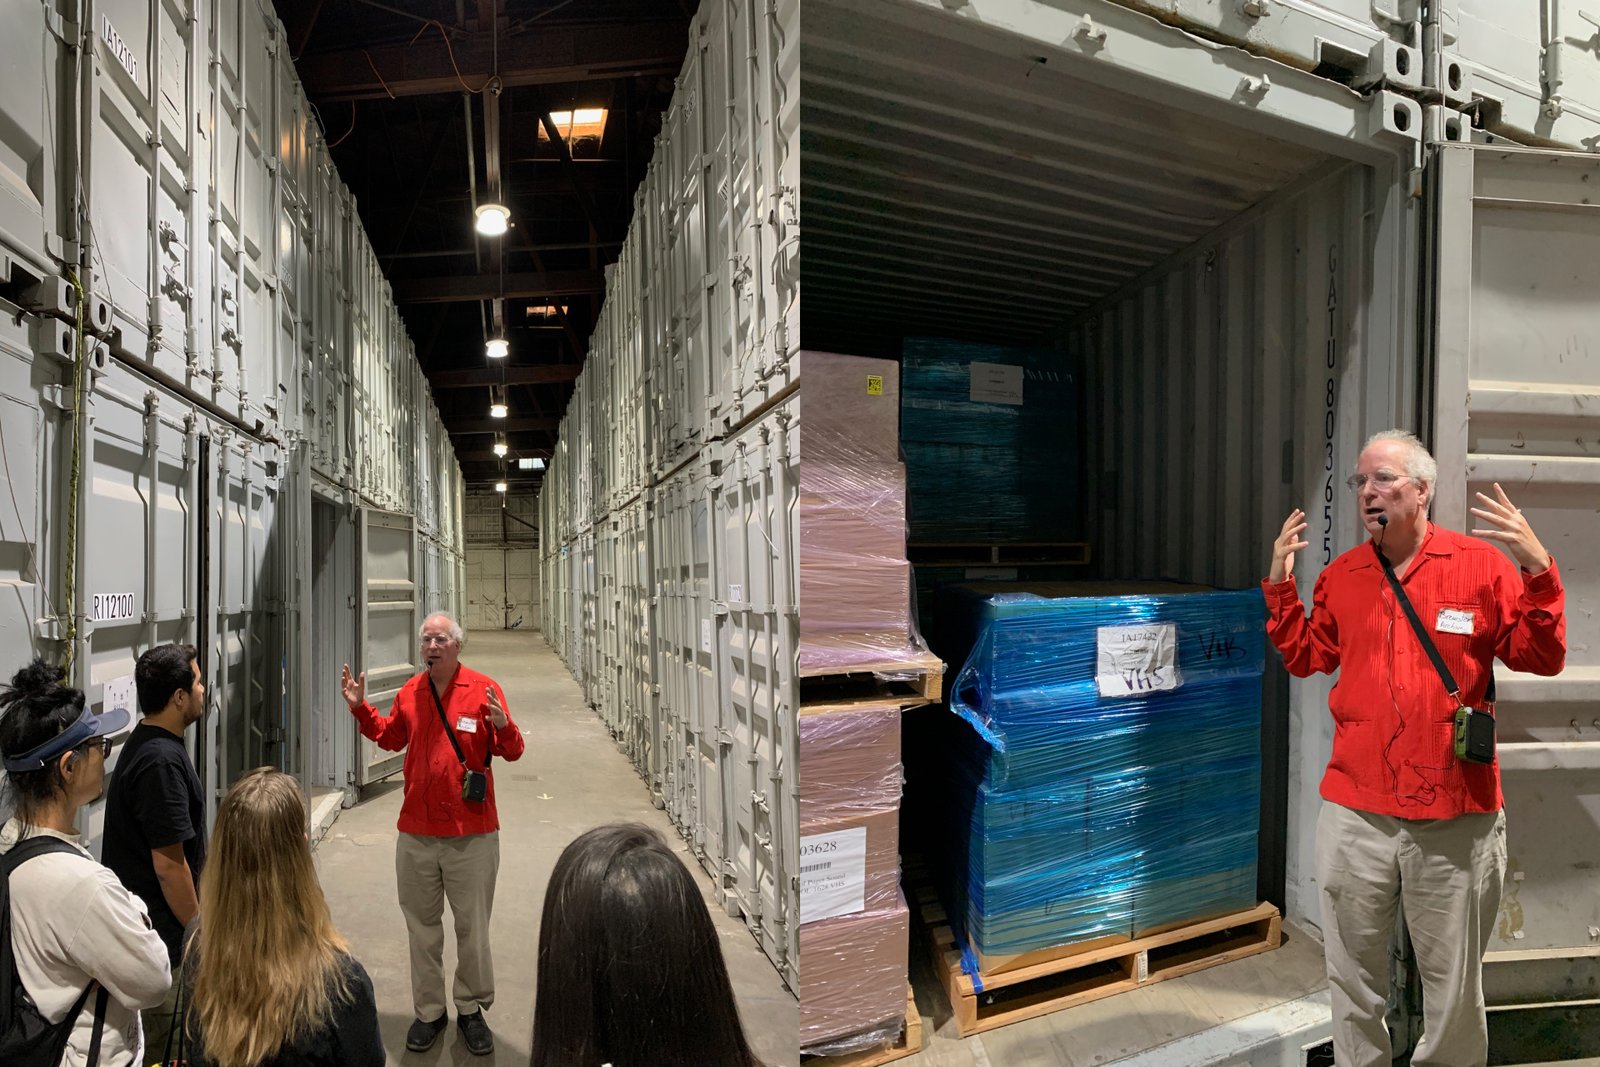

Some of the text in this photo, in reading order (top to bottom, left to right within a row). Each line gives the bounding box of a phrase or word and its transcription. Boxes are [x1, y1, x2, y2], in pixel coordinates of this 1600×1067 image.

[103, 16, 138, 82] IA12101
[1323, 243, 1337, 566] GATU 803655
[94, 593, 134, 620] RI12100
[1121, 665, 1164, 691] VHS
